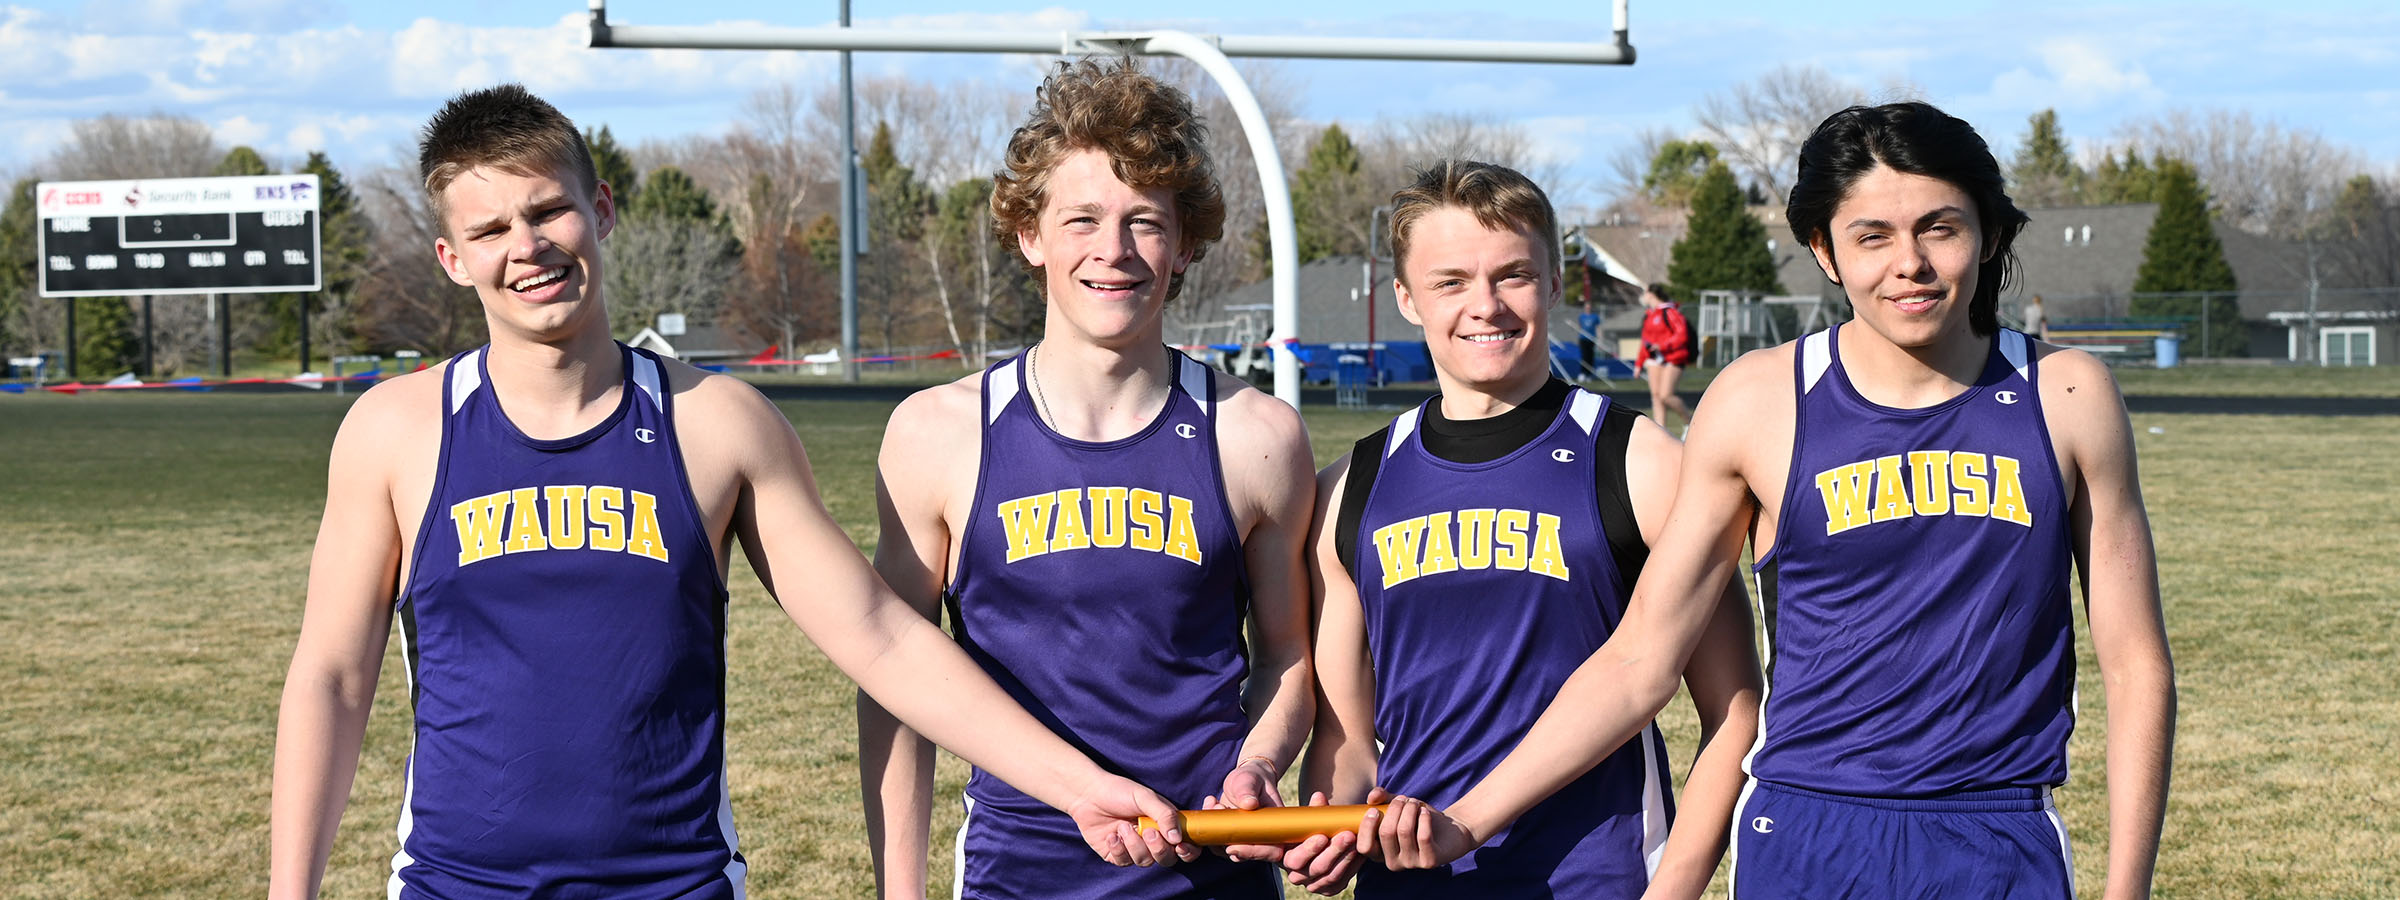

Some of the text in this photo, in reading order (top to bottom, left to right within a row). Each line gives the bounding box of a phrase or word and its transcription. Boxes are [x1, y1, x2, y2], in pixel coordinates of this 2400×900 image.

[202, 188, 233, 201] Bank
[262, 210, 306, 227] GUEST
[52, 217, 91, 232] HOME
[86, 254, 118, 270] DOWN
[1814, 449, 2033, 537] WAUSA
[449, 484, 669, 568] WAUSA
[997, 486, 1203, 566] WAUSA
[1372, 508, 1570, 591] WAUSA
